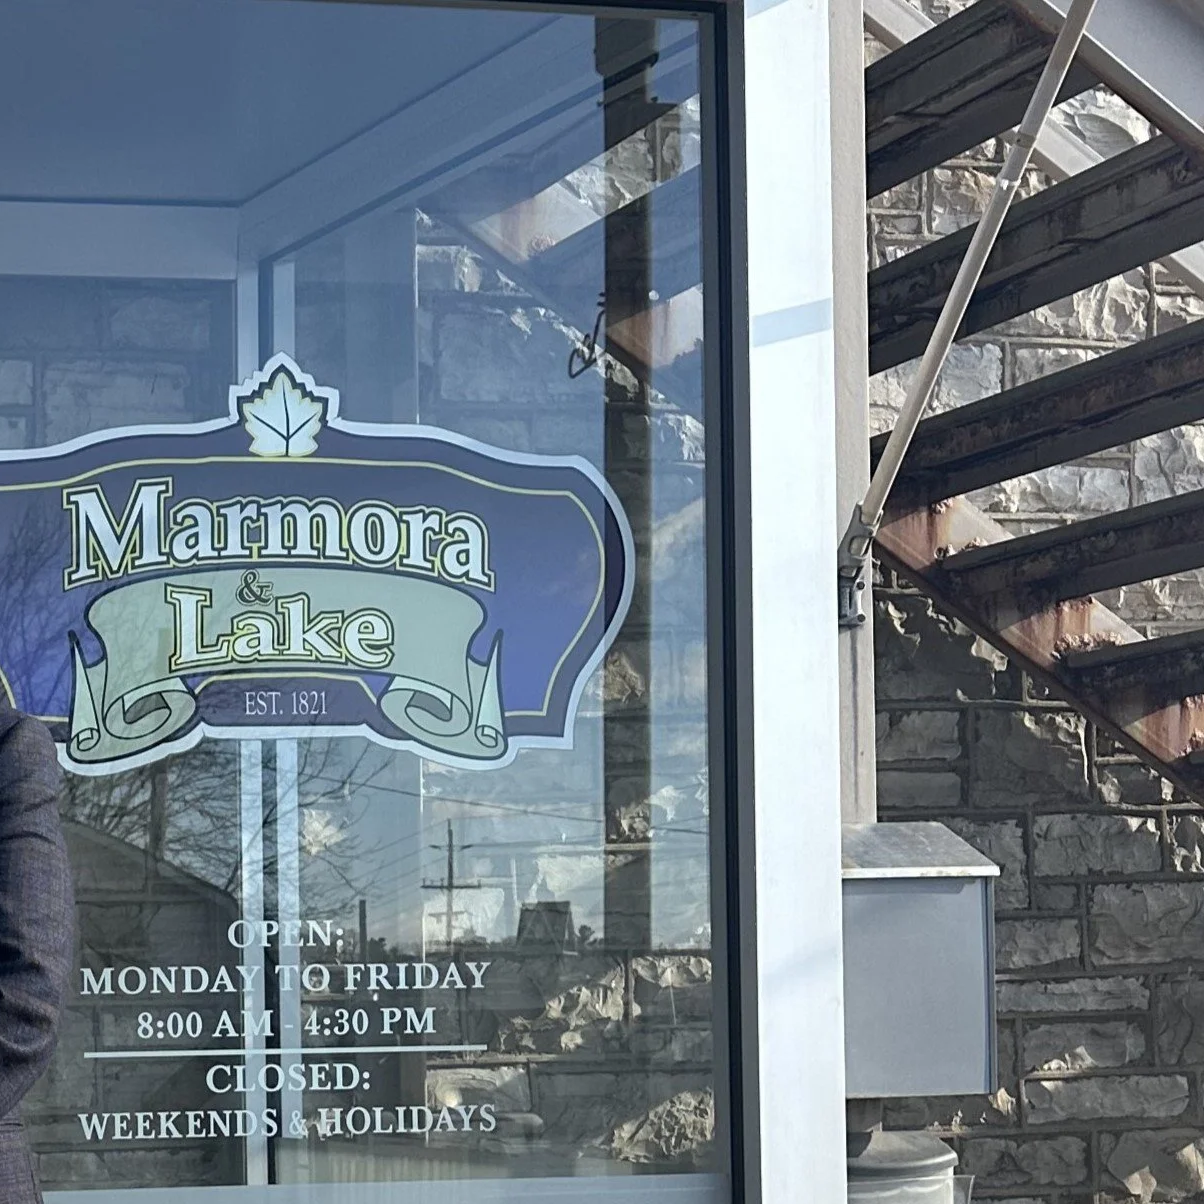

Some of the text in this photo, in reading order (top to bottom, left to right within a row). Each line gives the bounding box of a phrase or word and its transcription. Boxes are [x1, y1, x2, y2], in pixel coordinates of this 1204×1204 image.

[63, 478, 494, 592] Marmora
[236, 571, 273, 606] &
[165, 582, 394, 673] Lake
[244, 690, 328, 716] EST. 1821
[227, 920, 344, 948] OPEN:
[80, 962, 491, 995] MONDAY TO FRIDAY
[137, 1011, 202, 1039] 8:00
[212, 1009, 274, 1038] AM
[304, 1008, 369, 1036] 4:30
[380, 1006, 436, 1034] PM
[206, 1063, 370, 1093] CLOSED:
[78, 1104, 496, 1141] WEEKENDS & HOLIDAYS
